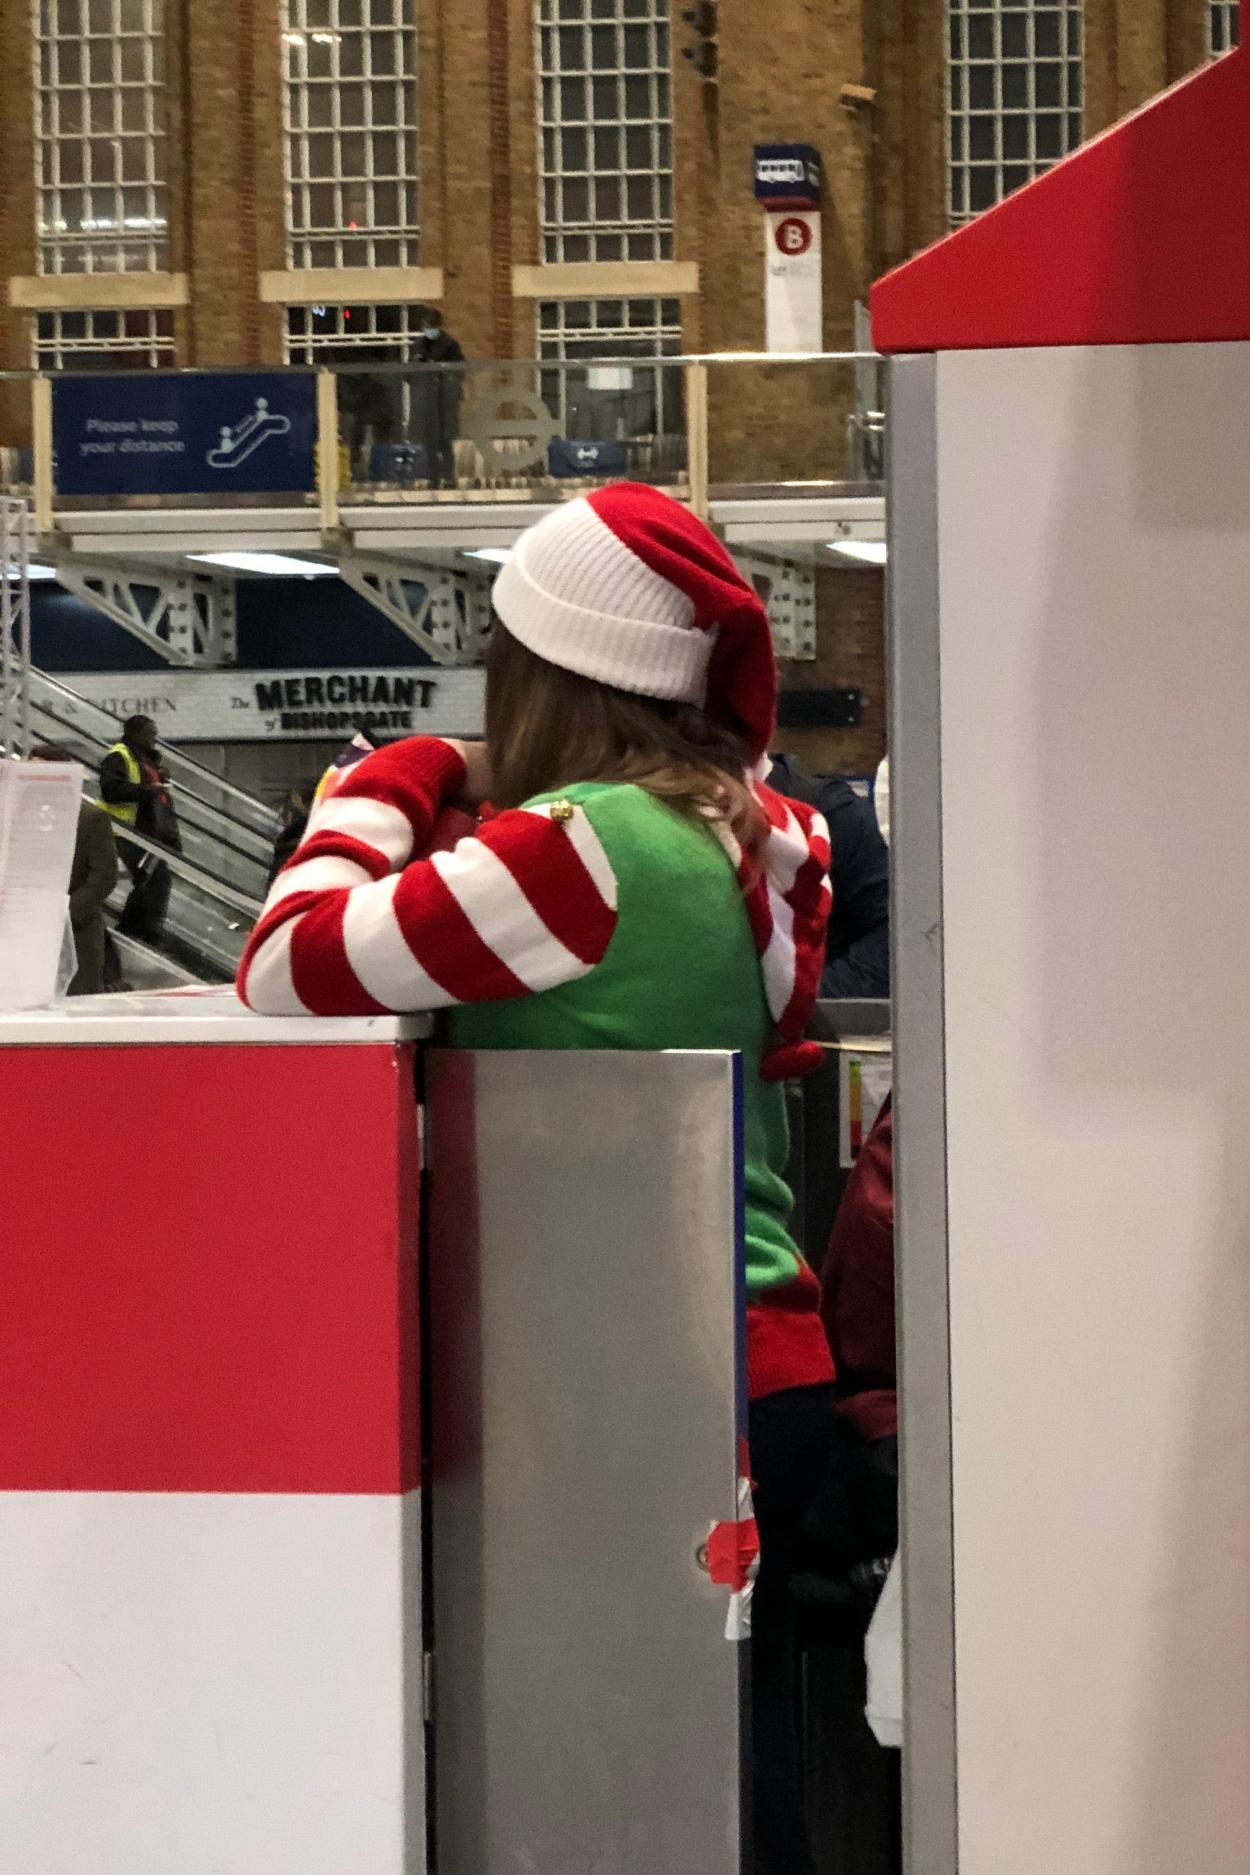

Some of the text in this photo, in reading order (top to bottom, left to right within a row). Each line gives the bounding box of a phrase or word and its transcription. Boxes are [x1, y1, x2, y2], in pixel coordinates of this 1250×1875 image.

[86, 419, 179, 434] Please keep
[80, 438, 185, 457] your distance
[254, 675, 437, 711] MERCHANT
[281, 711, 412, 730] BISHOPSGATE
